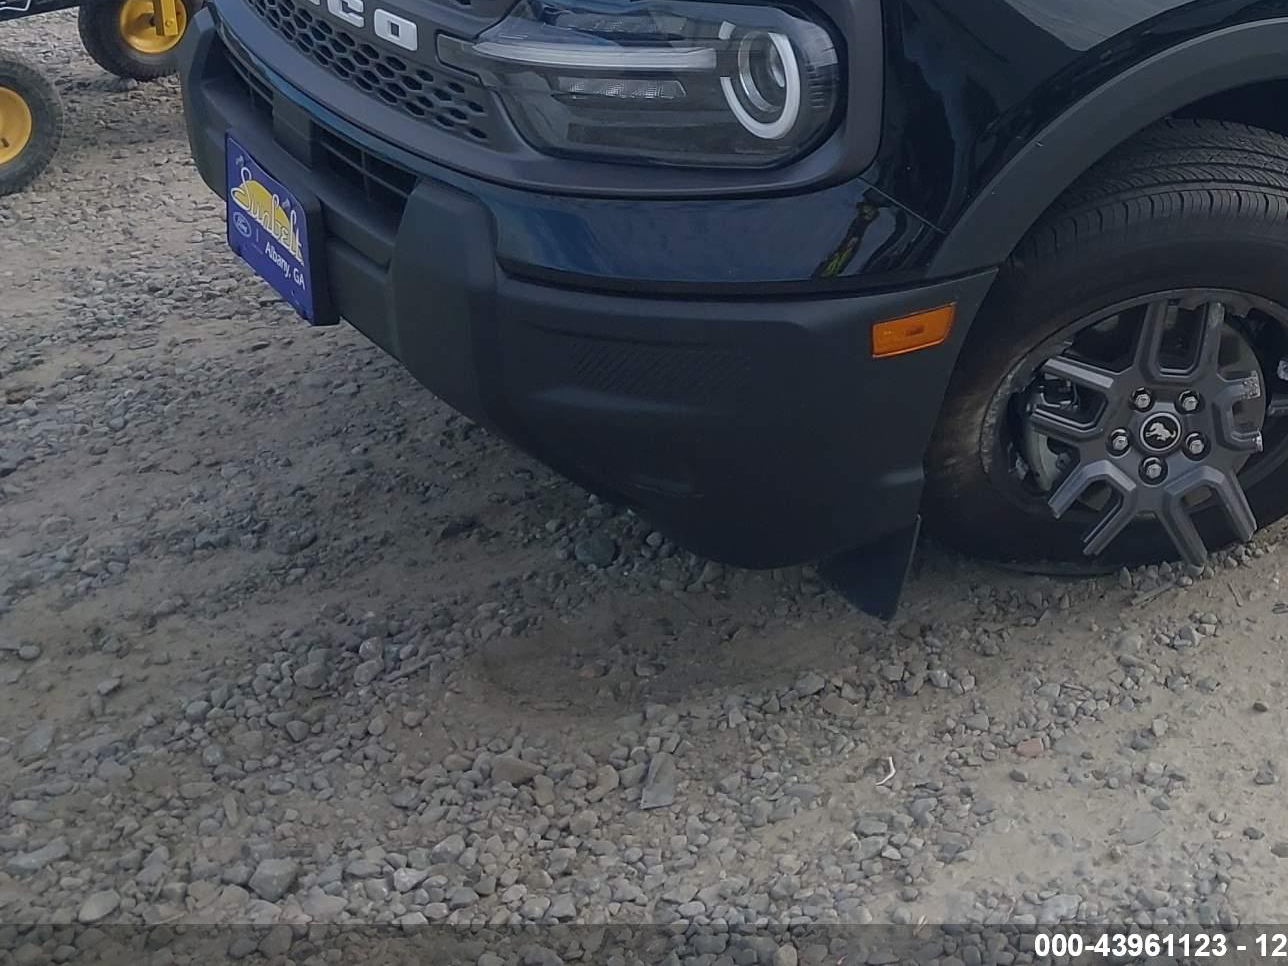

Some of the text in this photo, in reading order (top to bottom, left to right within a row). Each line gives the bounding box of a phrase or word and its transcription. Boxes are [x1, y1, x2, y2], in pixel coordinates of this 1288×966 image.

[231, 167, 304, 266] Sunbelt
[265, 241, 306, 290] Albany, GA
